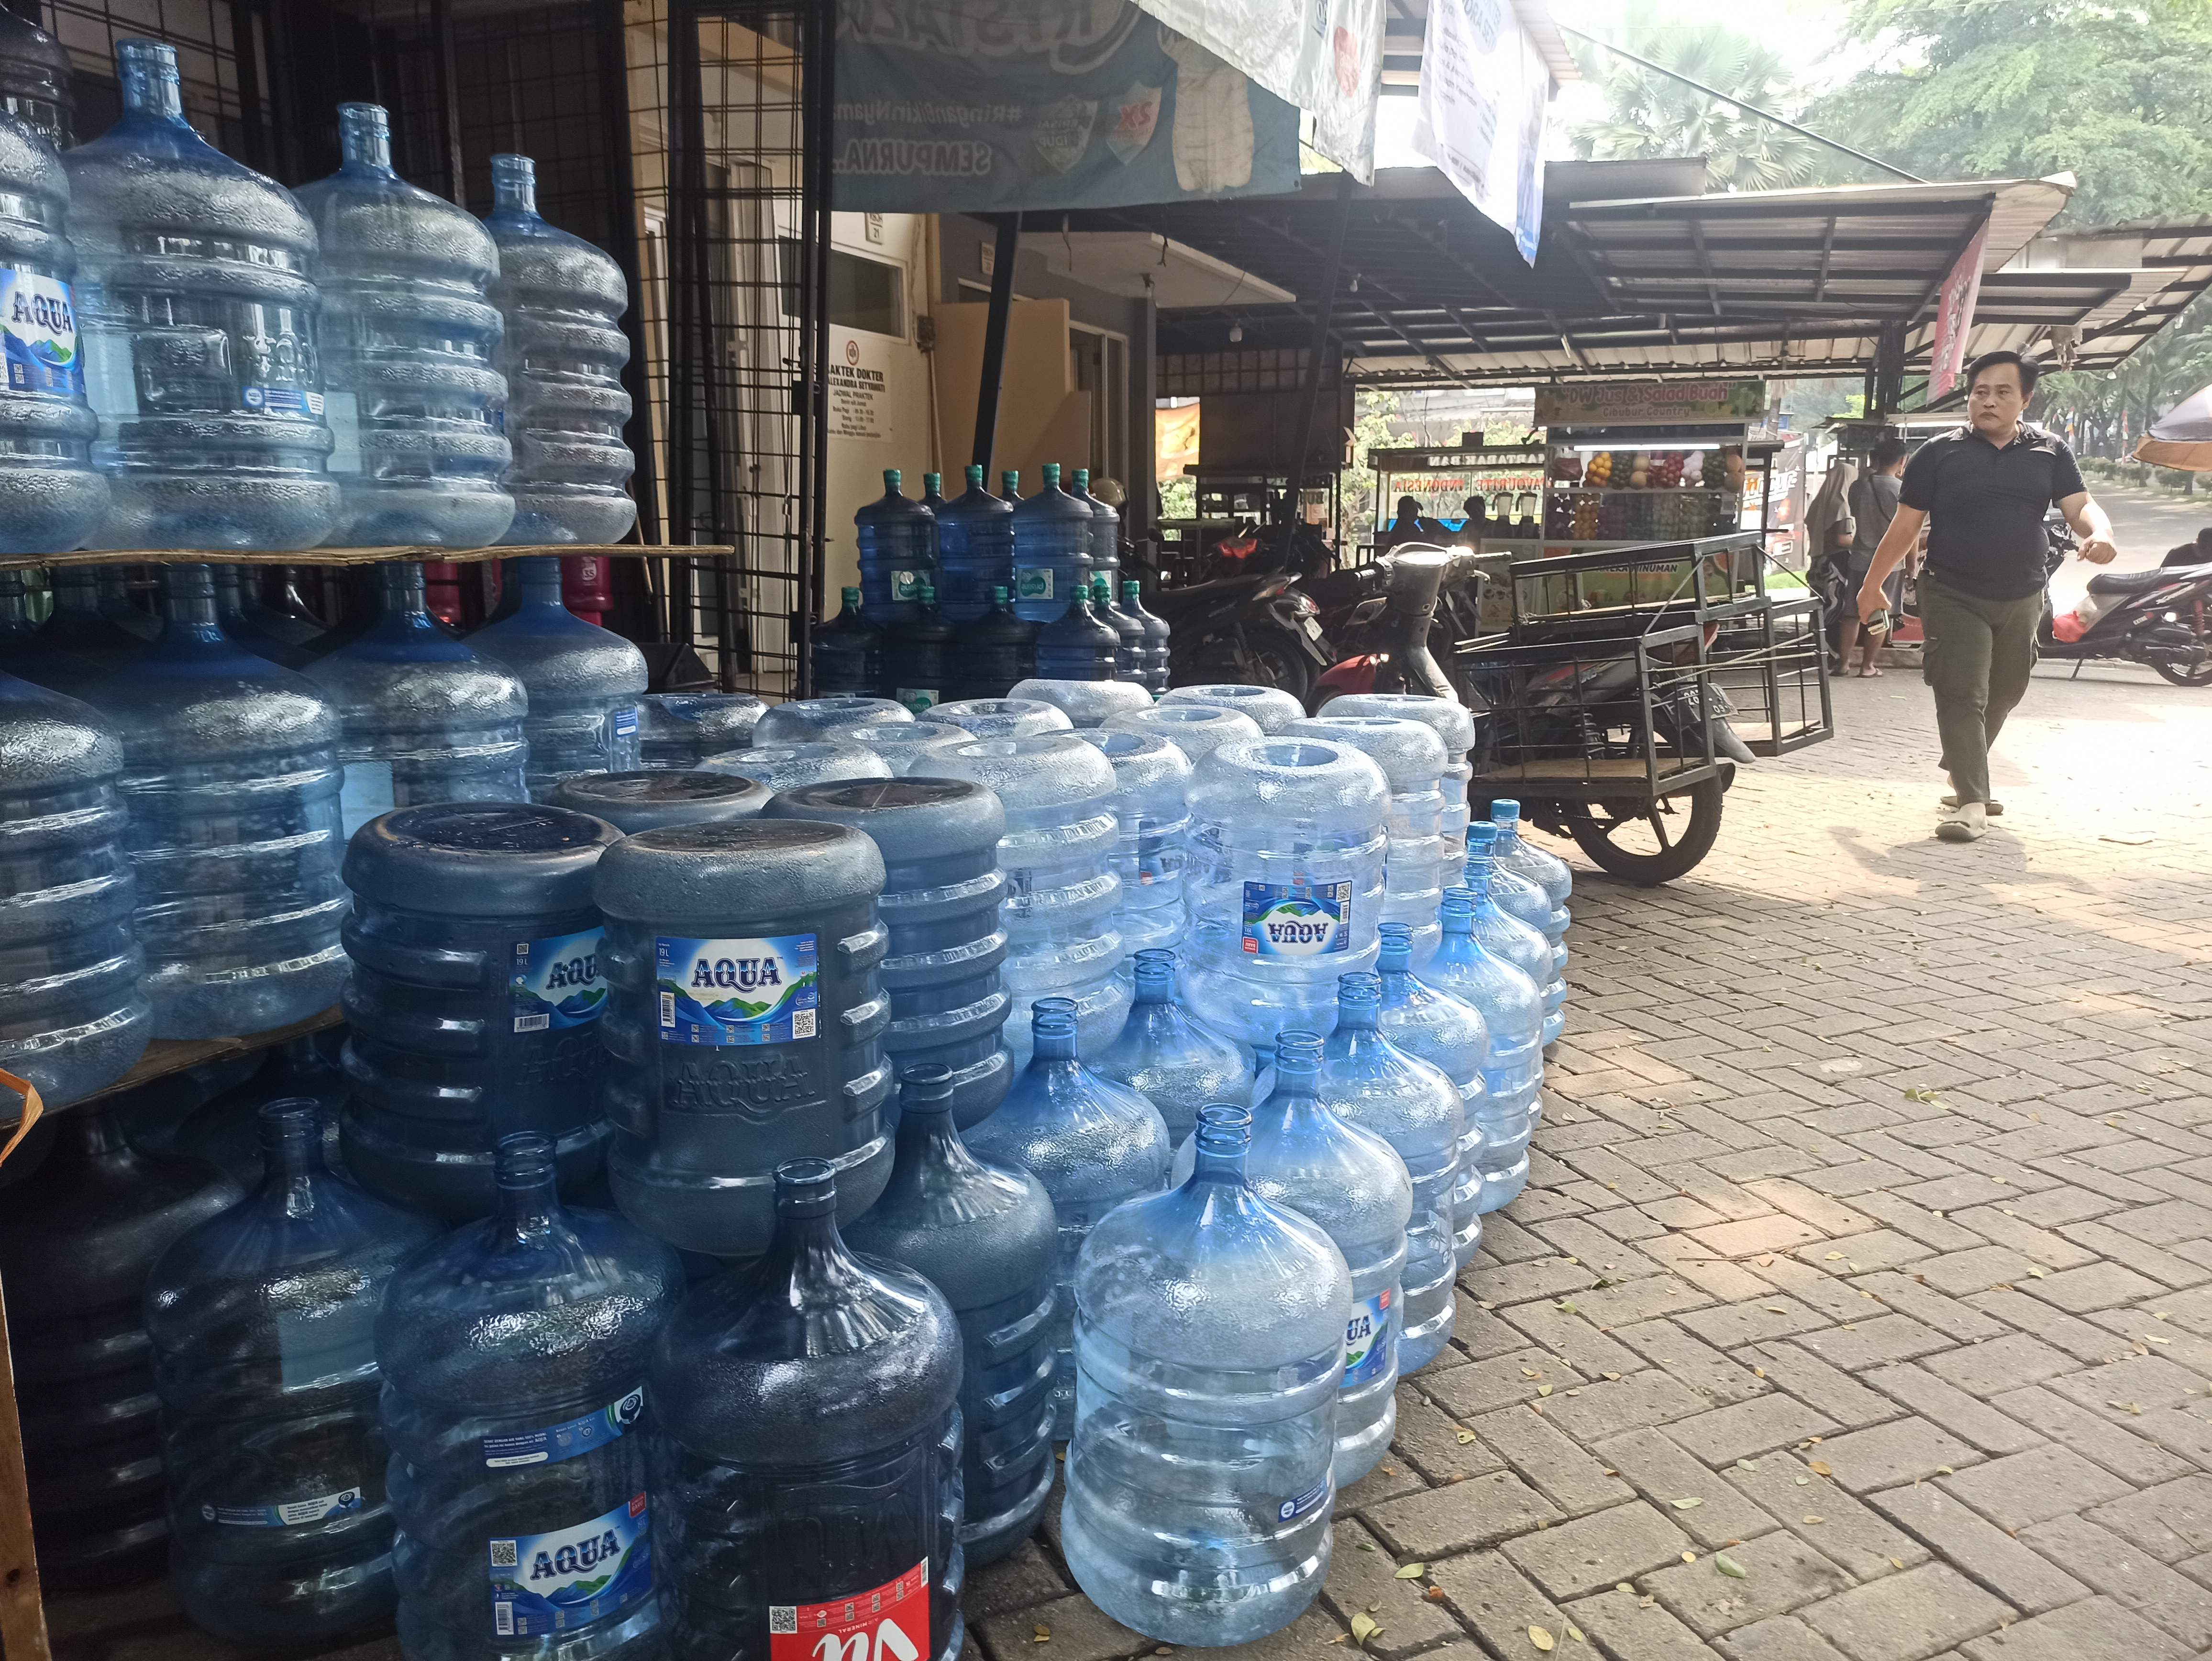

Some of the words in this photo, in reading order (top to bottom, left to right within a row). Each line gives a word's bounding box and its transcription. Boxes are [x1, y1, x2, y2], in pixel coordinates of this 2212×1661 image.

[874, 228, 880, 238] 21
[12, 291, 73, 336] AQUA
[829, 365, 855, 377] AKTEK
[857, 368, 884, 382] DOKTER
[833, 389, 852, 398] JADWAL
[853, 392, 873, 400] PRAKTEK
[1595, 387, 1623, 404] Jus
[1625, 386, 1641, 403] &
[1642, 384, 1687, 403] Salad
[1603, 406, 1643, 418] Cibubur
[1646, 406, 1690, 417] Country
[1021, 581, 1044, 591] pristine
[1267, 920, 1329, 944] AQUA
[545, 953, 598, 986] AQU
[691, 957, 782, 993] AQUA
[674, 1054, 815, 1113] AQUA
[632, 1499, 643, 1512] BARU
[530, 1529, 621, 1581] AQUA
[838, 1621, 868, 1634] MINERAL
